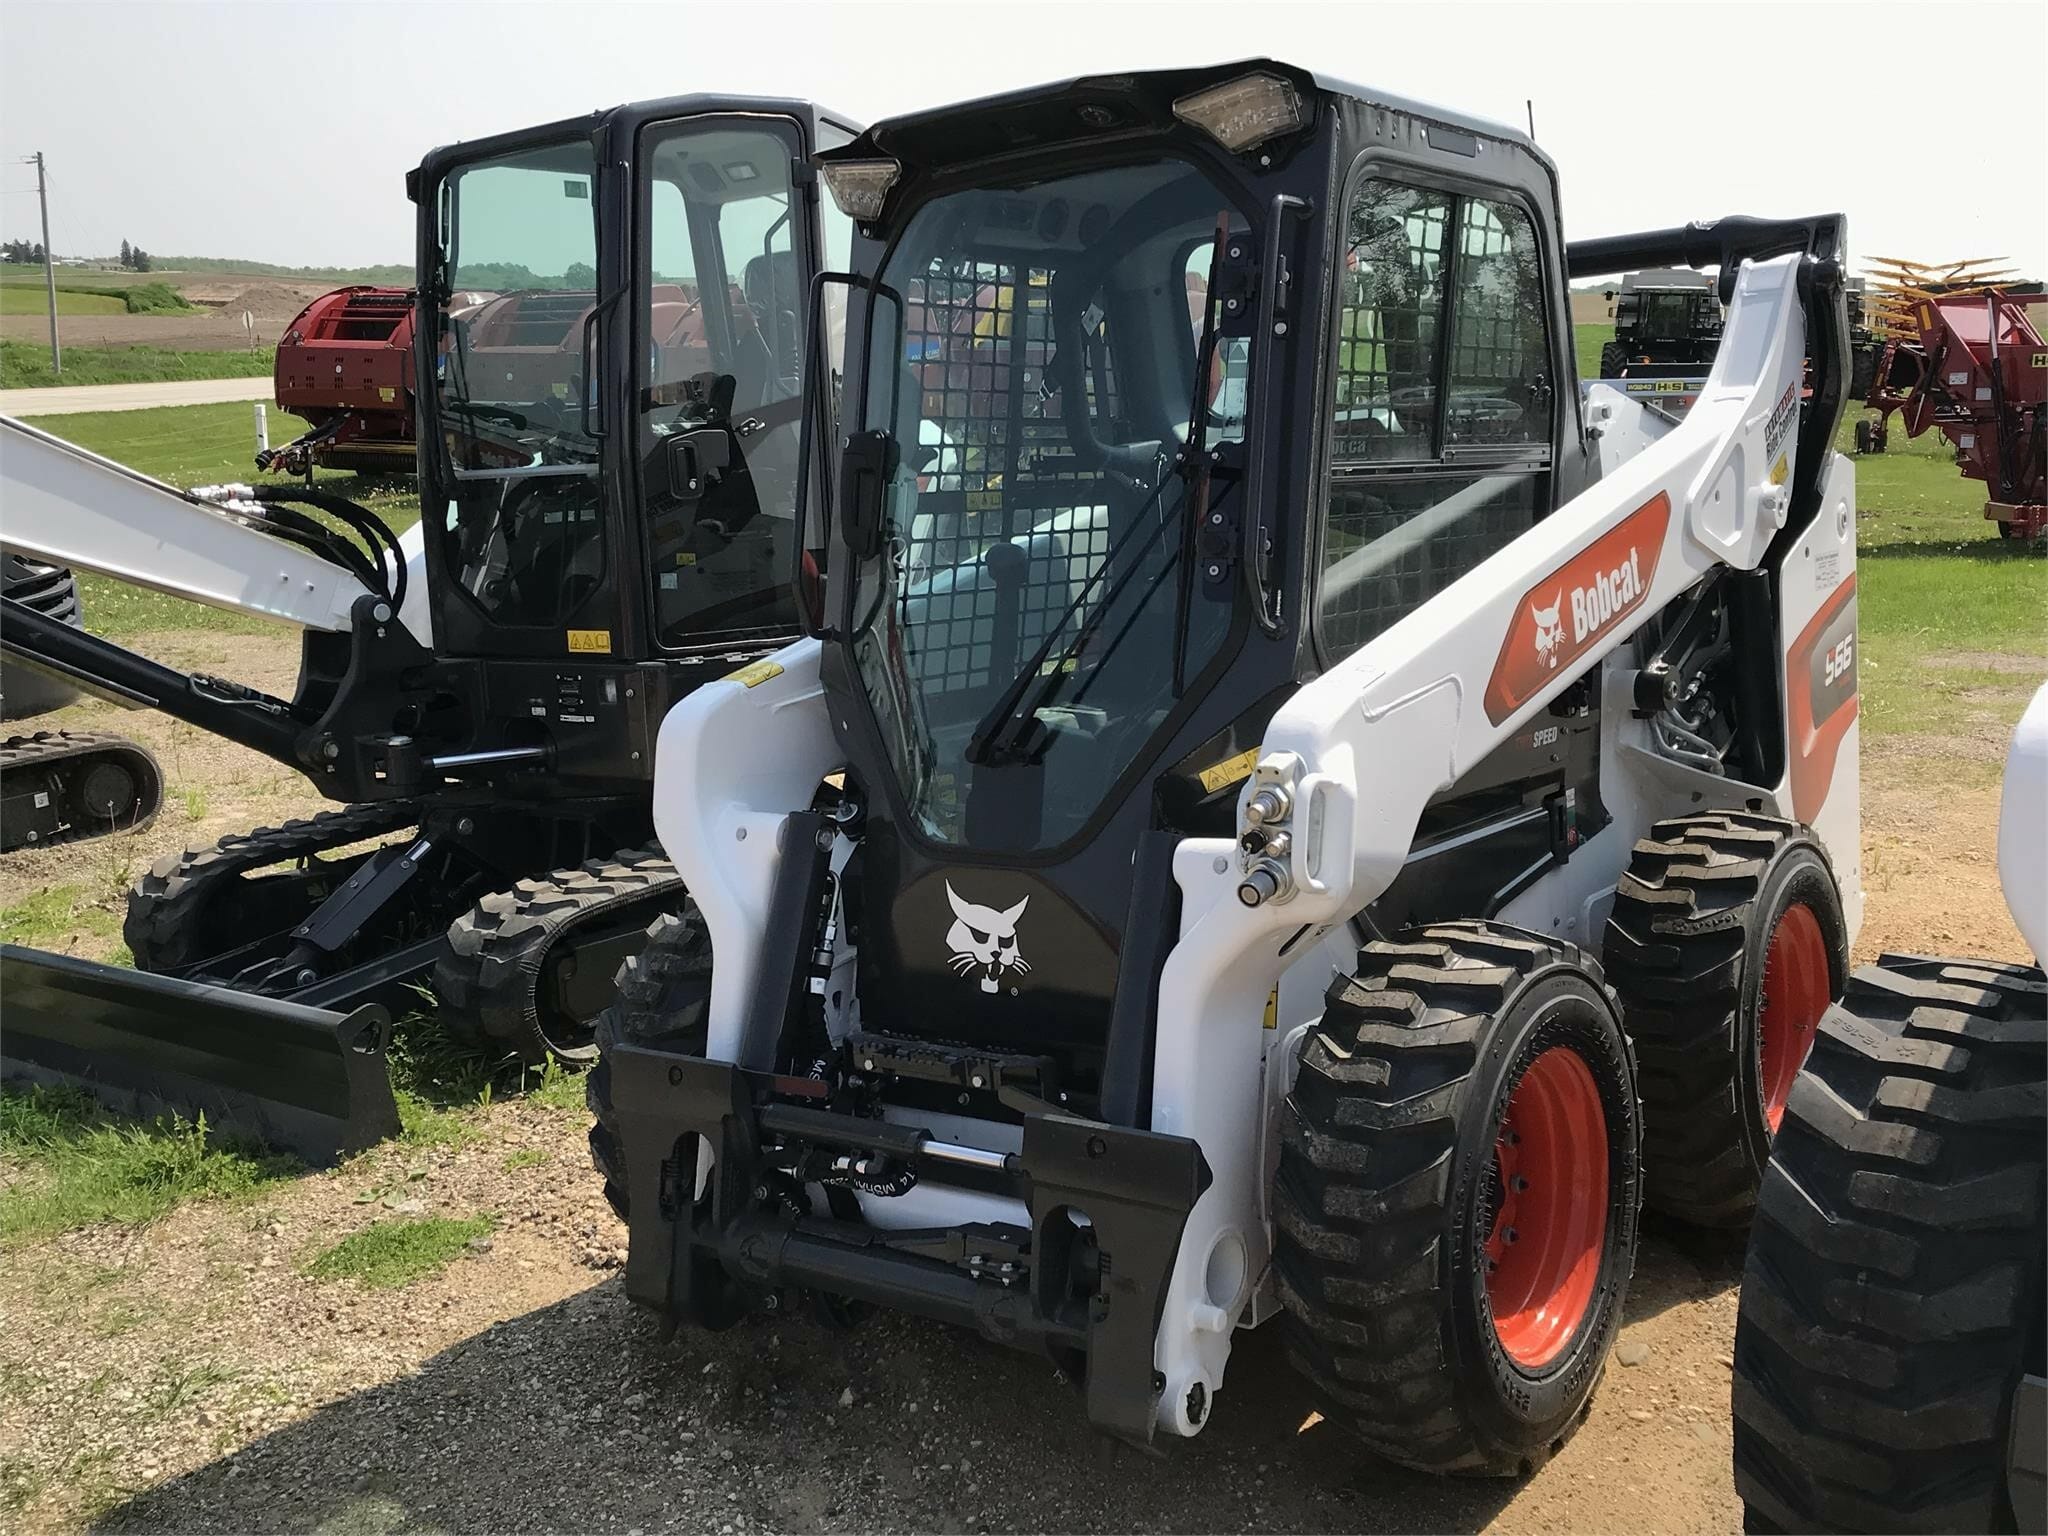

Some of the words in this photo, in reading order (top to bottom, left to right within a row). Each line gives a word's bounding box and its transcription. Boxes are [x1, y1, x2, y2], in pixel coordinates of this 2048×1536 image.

[1571, 546, 1641, 645] Bobcat
[1825, 633, 1853, 687] S66
[1533, 726, 1558, 748] SPEED
